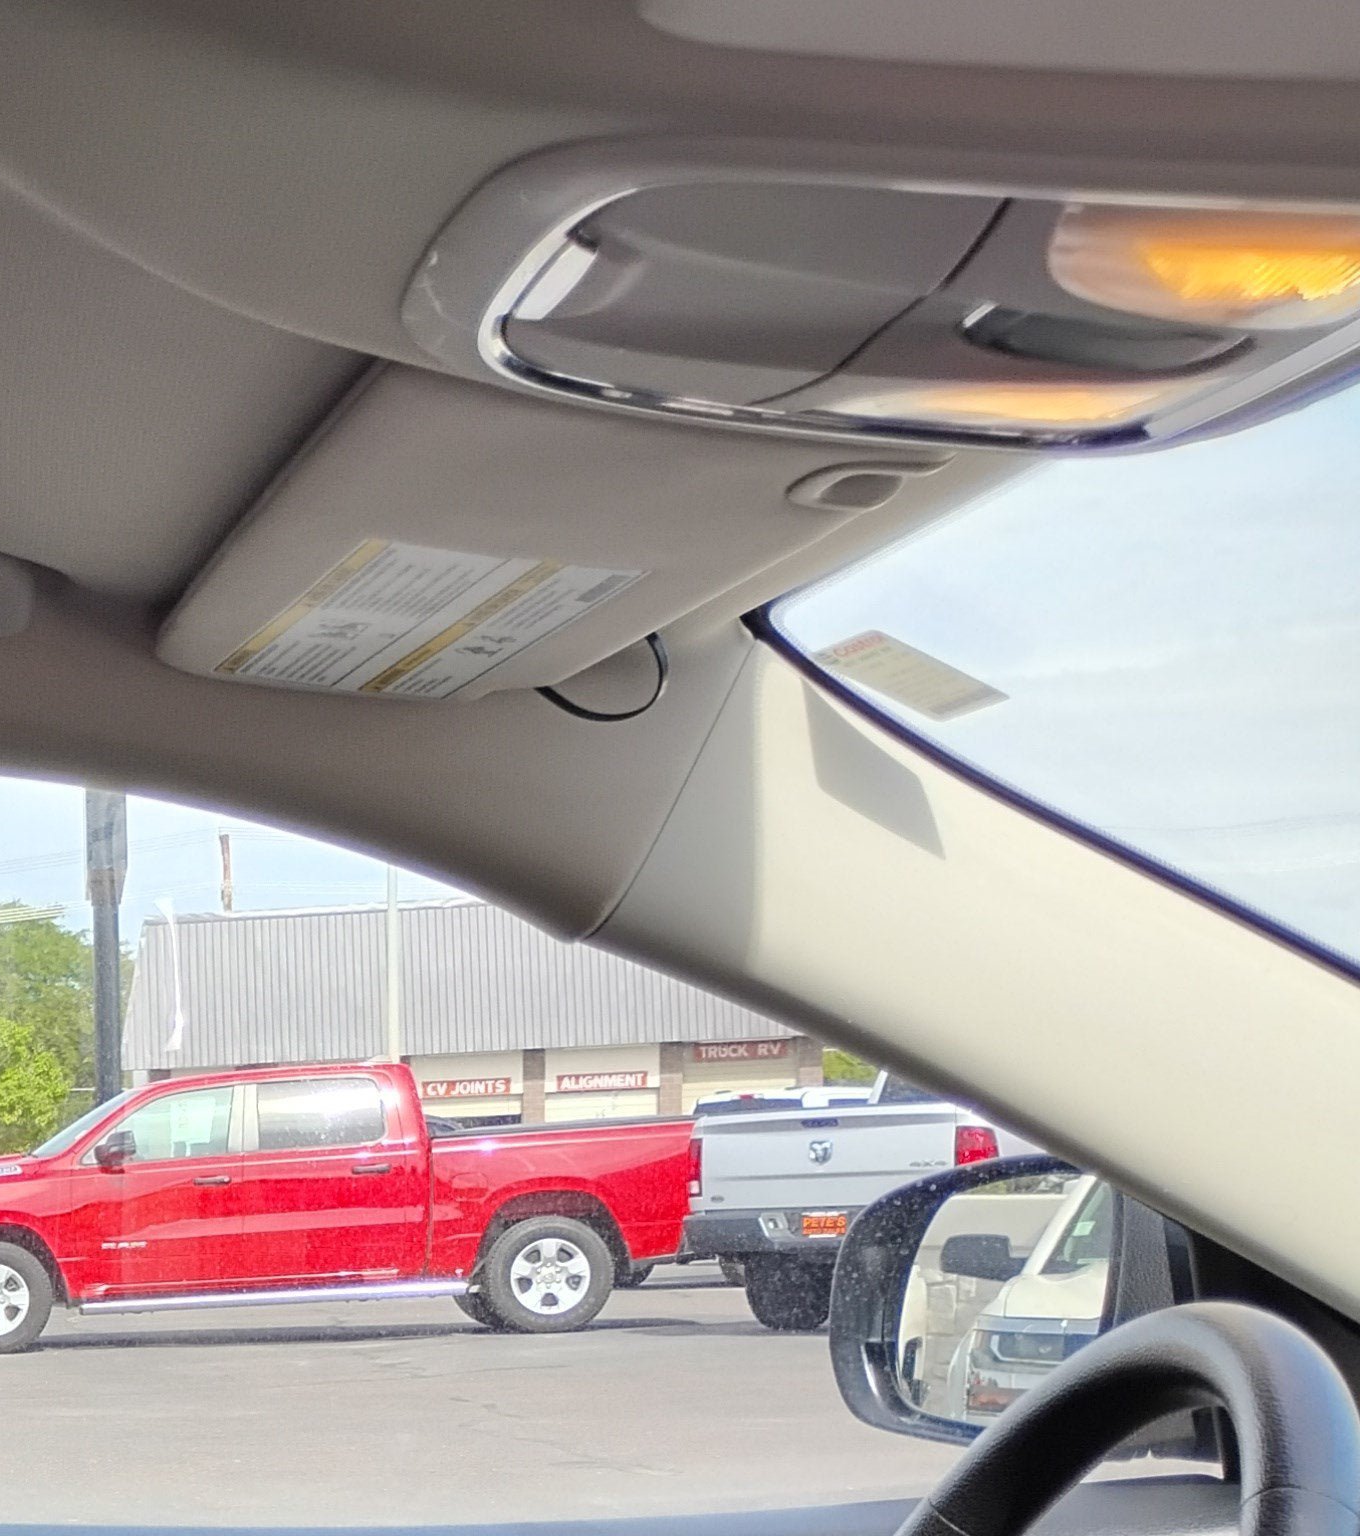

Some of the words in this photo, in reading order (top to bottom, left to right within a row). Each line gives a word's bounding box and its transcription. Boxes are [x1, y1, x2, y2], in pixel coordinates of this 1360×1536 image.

[699, 1043, 749, 1059] TRUCK
[757, 1041, 782, 1056] RV
[426, 1082, 448, 1096] CV
[450, 1079, 507, 1096] JOINTS
[560, 1072, 644, 1091] ALIGNMENT
[803, 1215, 847, 1228] PETE'S
